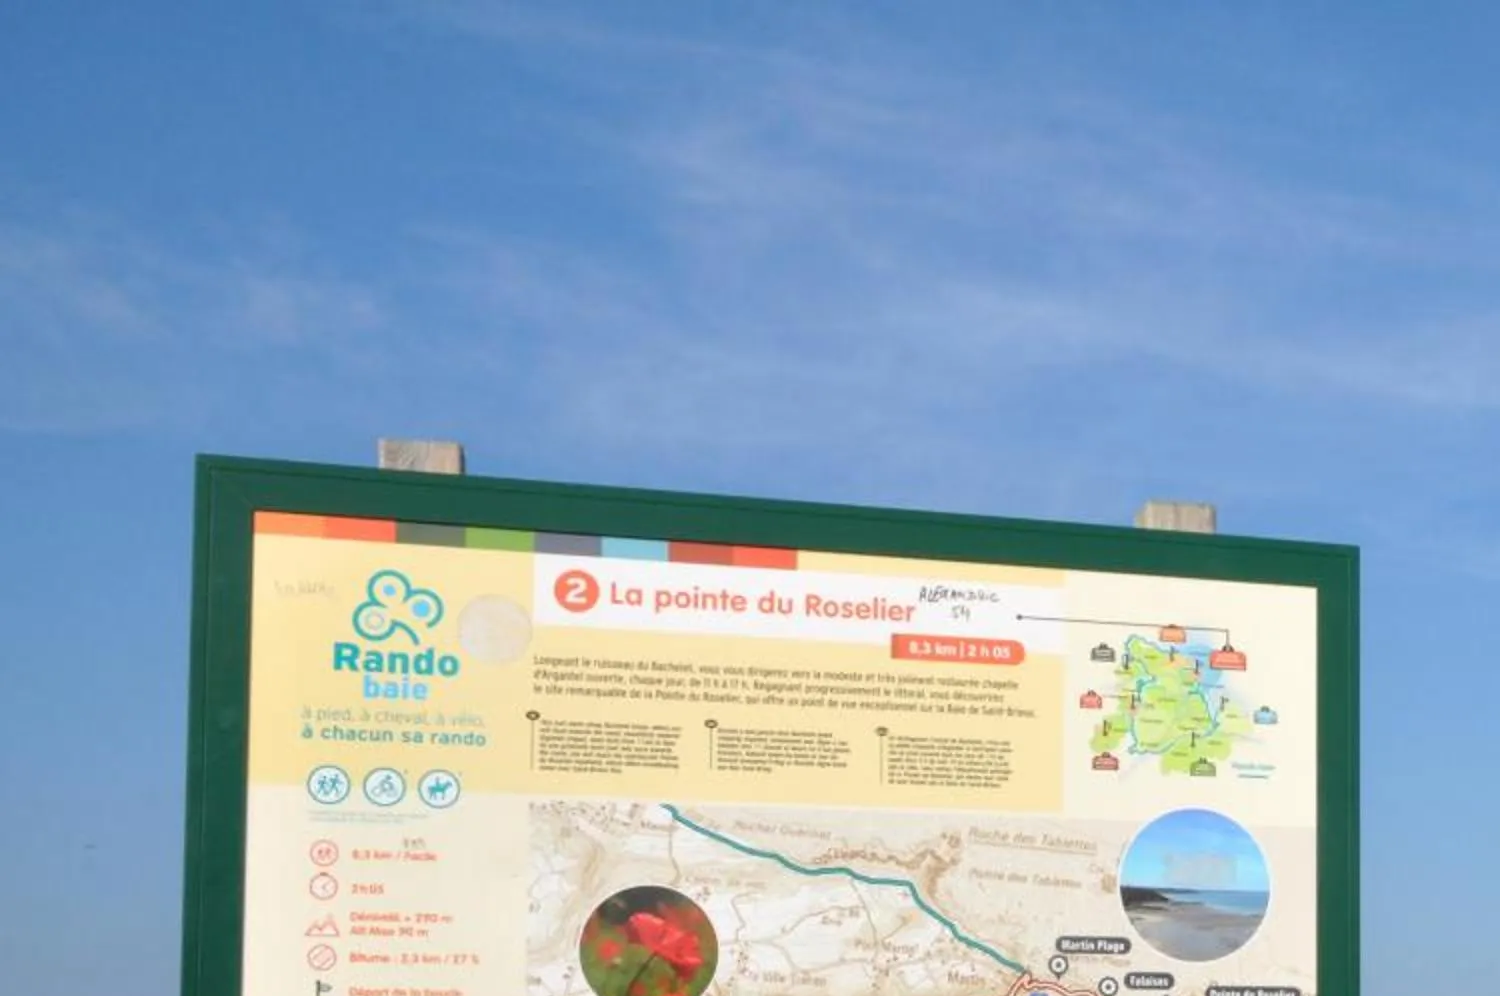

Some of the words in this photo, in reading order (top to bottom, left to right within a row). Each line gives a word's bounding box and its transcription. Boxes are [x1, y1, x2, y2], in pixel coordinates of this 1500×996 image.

[565, 578, 588, 603] 2
[611, 581, 643, 606] La
[655, 586, 746, 613] pointe
[758, 590, 792, 614] du
[806, 594, 915, 621] Roselier
[333, 642, 459, 677] Rando
[936, 642, 957, 657] km
[968, 645, 976, 657] 2
[982, 643, 989, 657] h
[363, 674, 427, 700] baie
[302, 724, 313, 739] à
[320, 726, 394, 742] chacun
[402, 730, 423, 743] sa
[431, 730, 486, 746] rando
[1061, 939, 1095, 951] Martin
[1098, 939, 1125, 953] Plage
